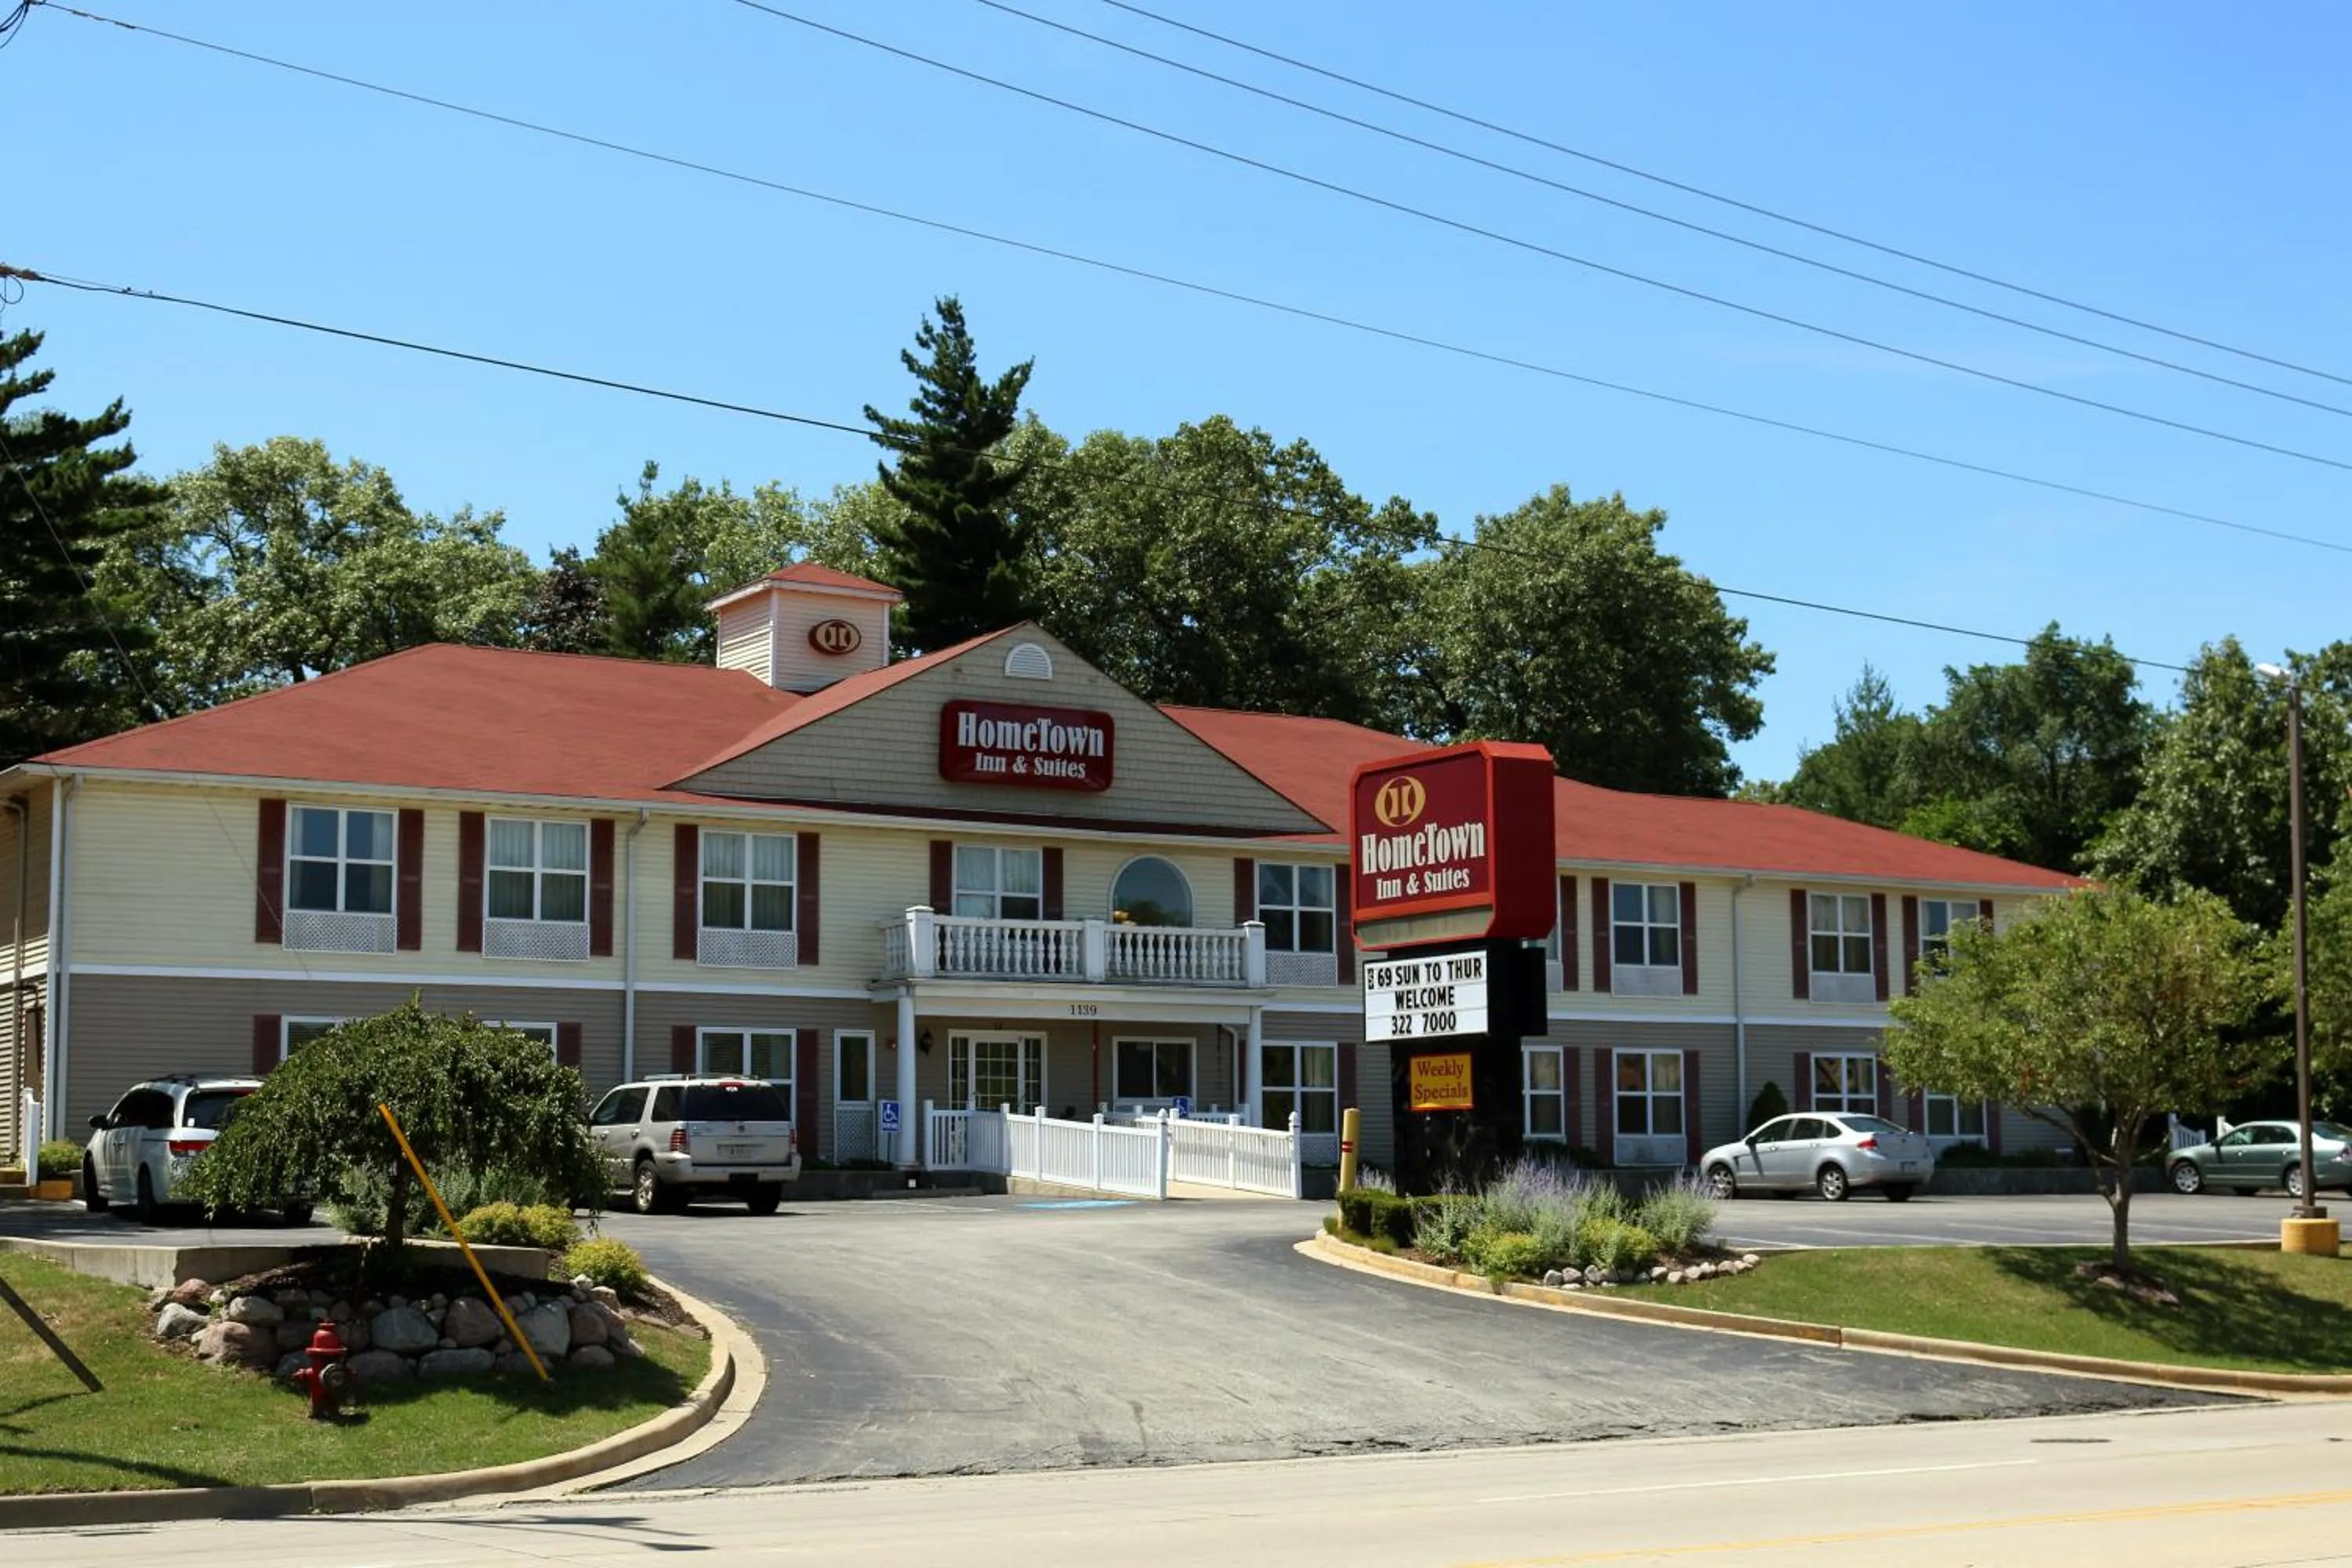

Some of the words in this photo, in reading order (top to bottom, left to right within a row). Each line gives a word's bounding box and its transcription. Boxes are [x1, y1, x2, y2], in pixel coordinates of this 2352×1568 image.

[957, 711, 1105, 757] HomeTown
[975, 752, 1007, 773] Inn
[1012, 755, 1028, 775] &
[1034, 757, 1087, 779] Suites
[1361, 822, 1486, 876] HomeTown
[1376, 877, 1402, 901] Inn
[1406, 872, 1420, 895] &
[1424, 867, 1471, 894] Suites
[1396, 964, 1420, 985] SUN
[1425, 962, 1442, 982] TO
[1447, 957, 1482, 980] THUR
[1069, 1004, 1098, 1016] 1139
[1395, 985, 1455, 1011] WELCOME
[1392, 1015, 1412, 1036] 322
[1421, 1011, 1457, 1033] 7000
[1417, 1058, 1465, 1080] Weekly
[1414, 1082, 1468, 1103] Specials
